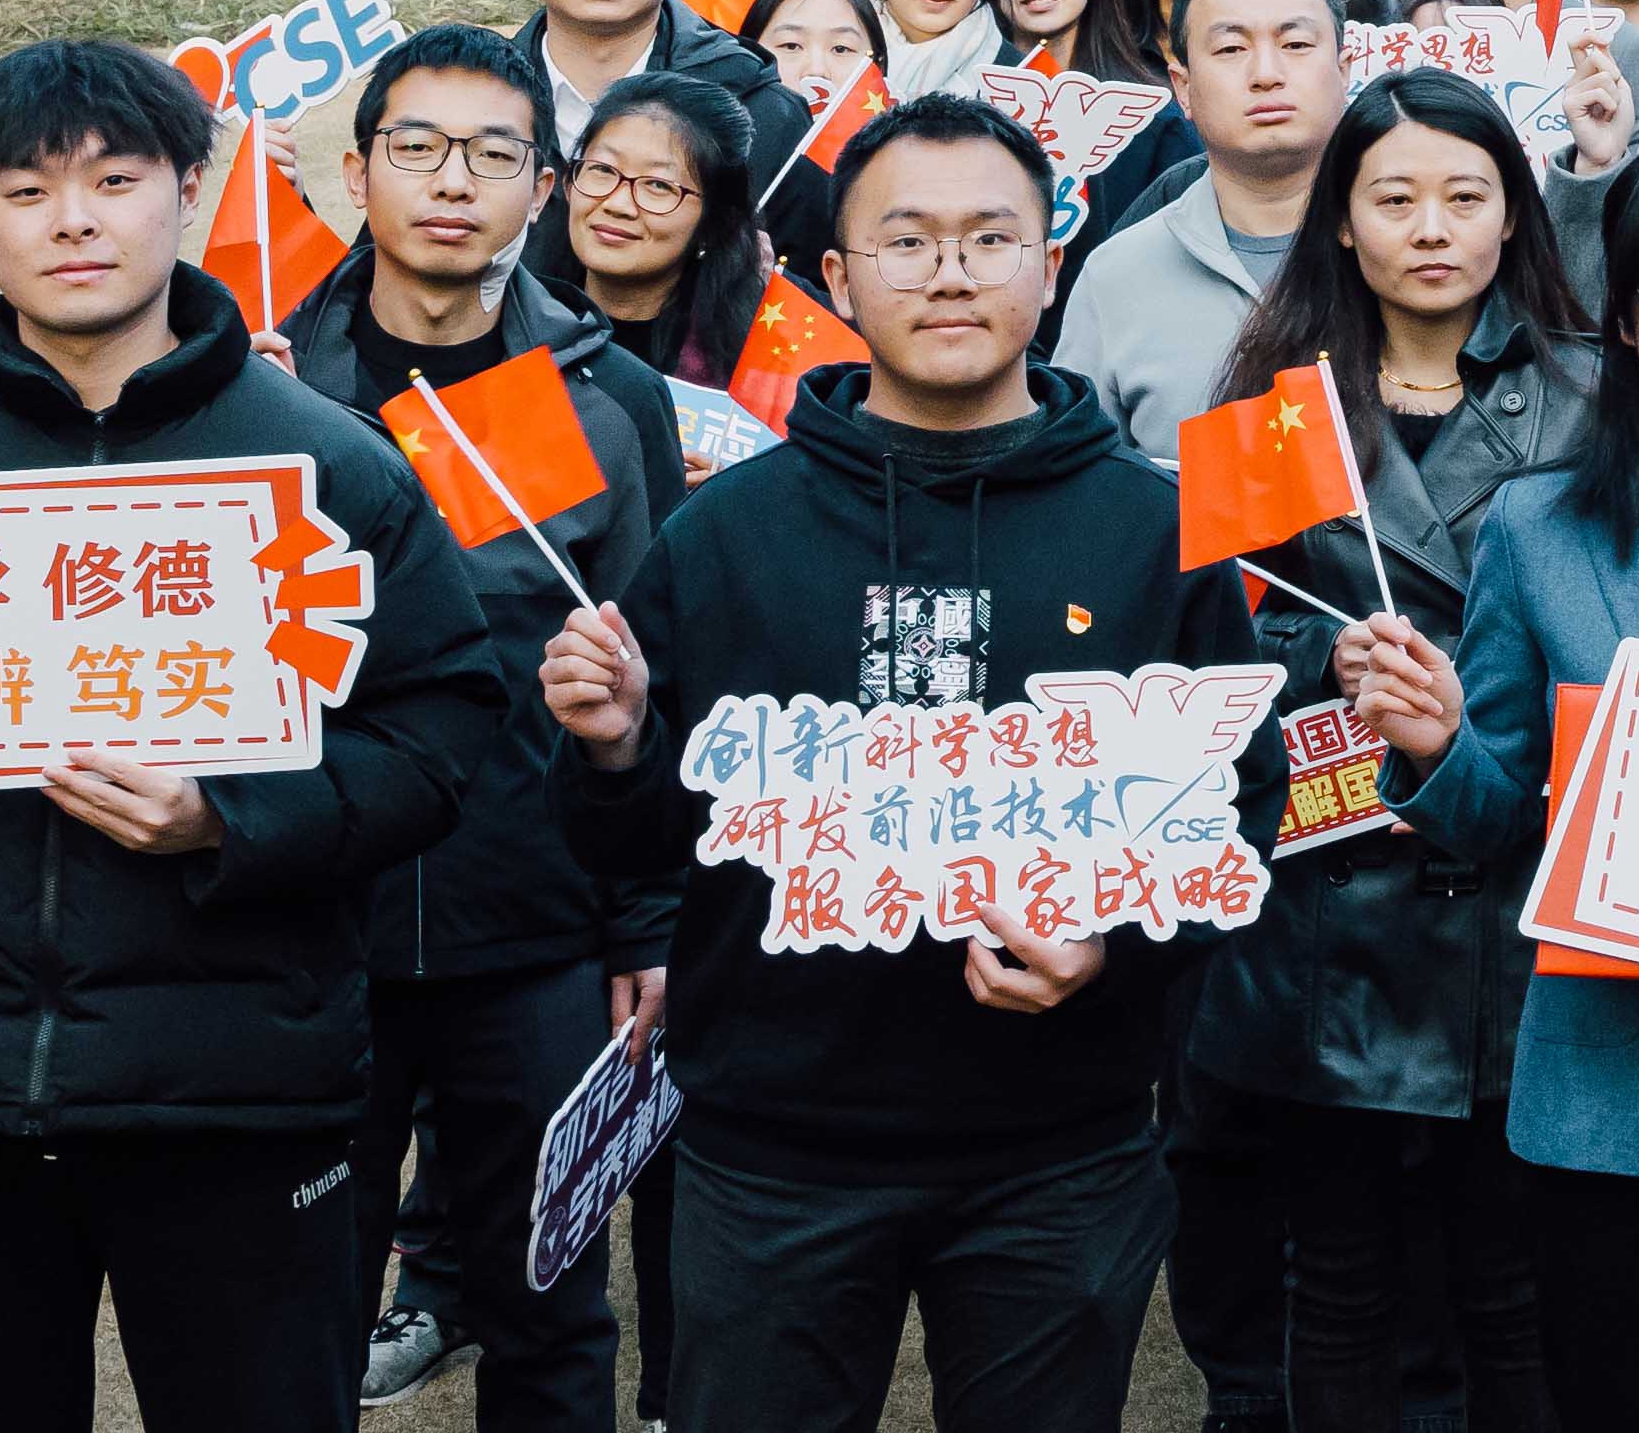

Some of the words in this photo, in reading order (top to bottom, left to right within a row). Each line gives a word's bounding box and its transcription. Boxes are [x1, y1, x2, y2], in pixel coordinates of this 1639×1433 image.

[1536, 114, 1572, 131] CS
[692, 703, 1101, 799] 创新科学思想
[708, 773, 1117, 865] 研发前沿技术
[1162, 816, 1228, 843] CSE
[775, 841, 1260, 940] 服务国家战略
[292, 1161, 351, 1208] chinism
